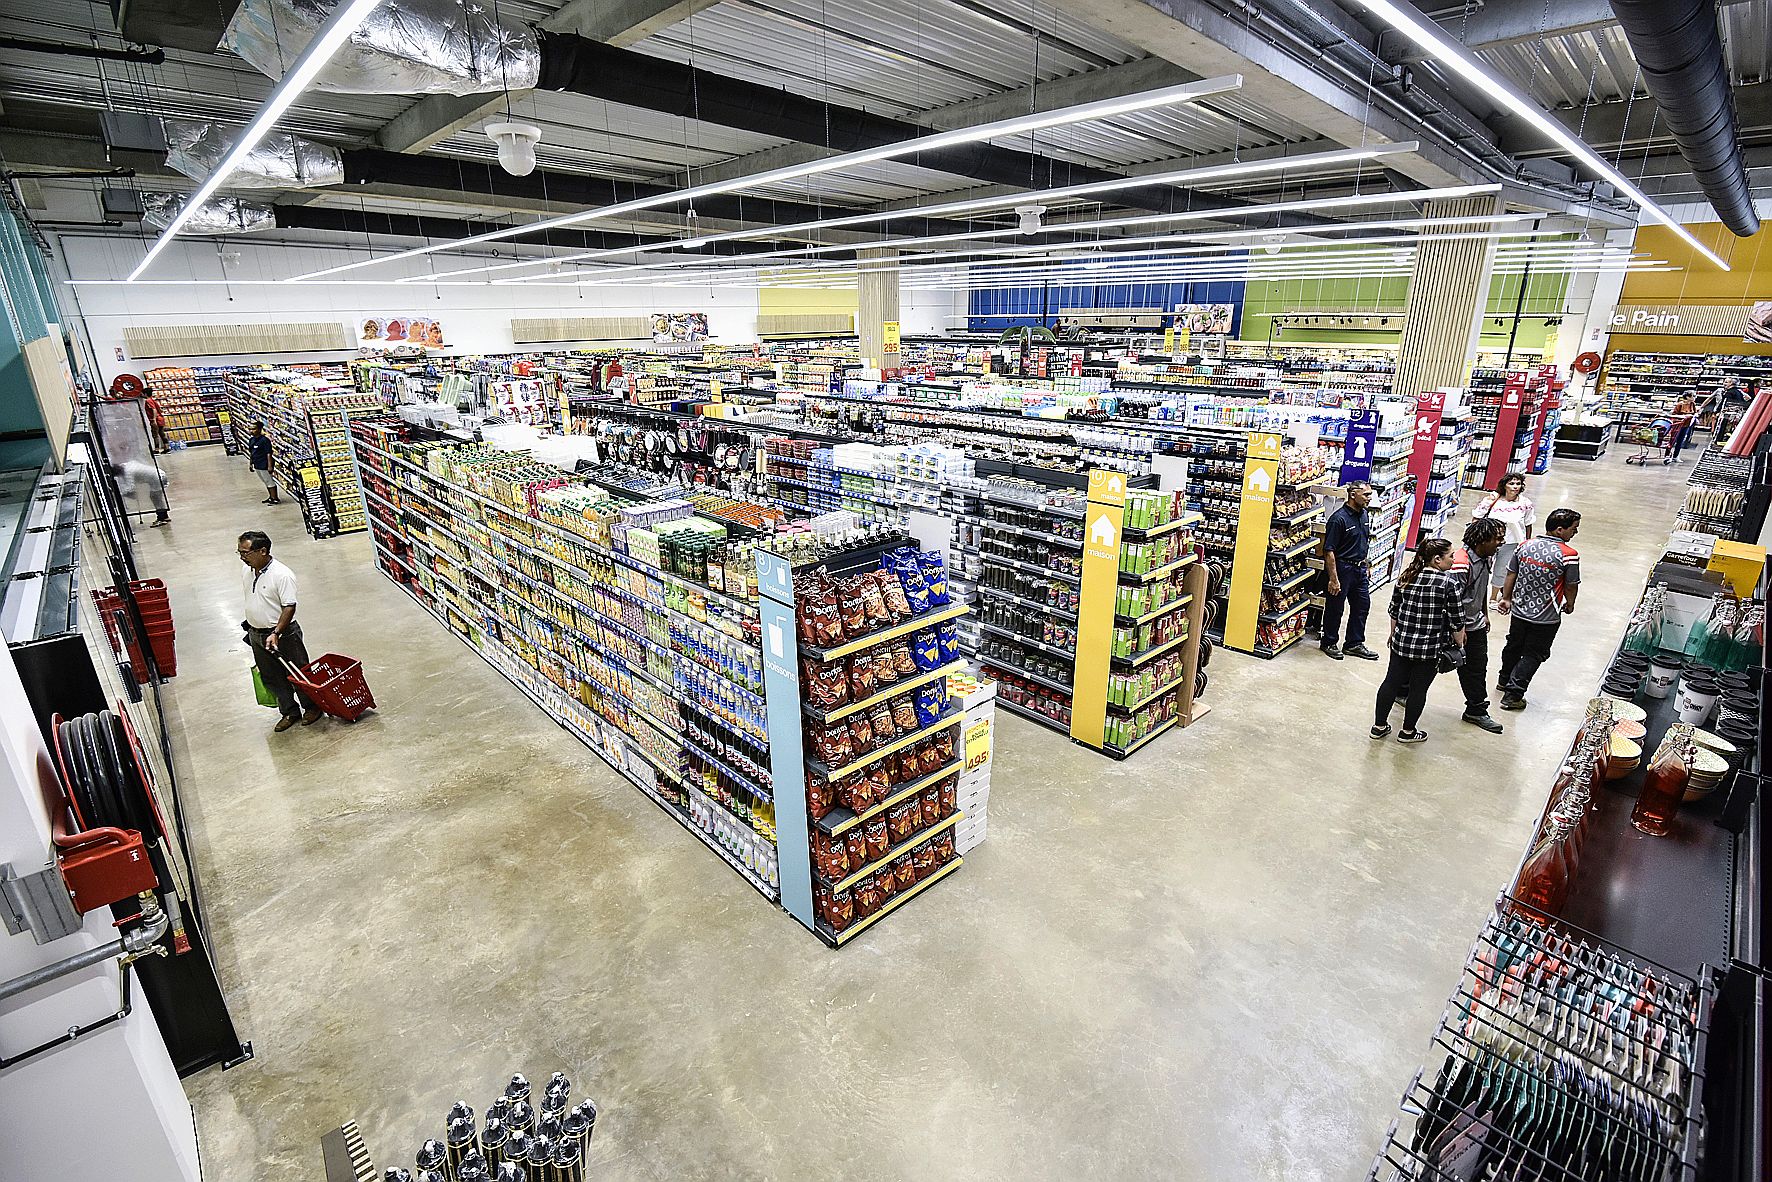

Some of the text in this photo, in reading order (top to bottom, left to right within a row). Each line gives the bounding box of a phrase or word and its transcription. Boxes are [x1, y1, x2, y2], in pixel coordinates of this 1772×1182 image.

[1607, 310, 1680, 327] le Pain
[1344, 459, 1370, 468] droguerie
[1091, 471, 1103, 480] 10
[1100, 493, 1122, 502] maison
[1244, 494, 1271, 503] maison
[1087, 548, 1116, 561] maison
[1666, 551, 1698, 563] Carrefour
[765, 582, 790, 599] boissons
[765, 656, 796, 682] boissons
